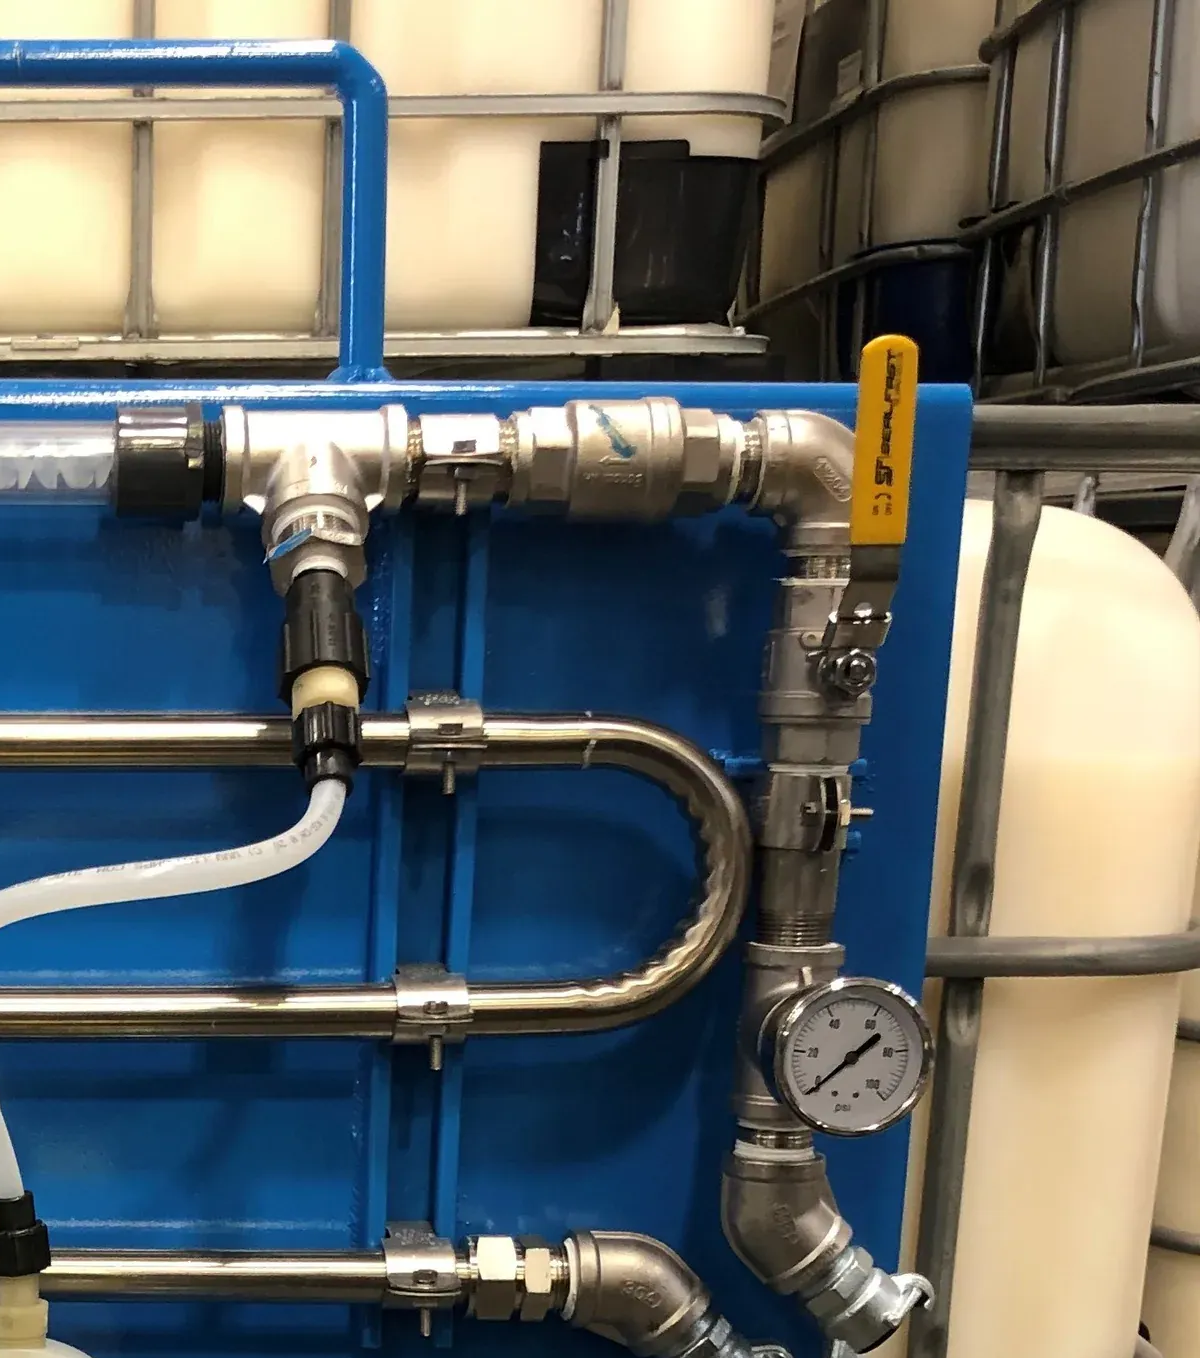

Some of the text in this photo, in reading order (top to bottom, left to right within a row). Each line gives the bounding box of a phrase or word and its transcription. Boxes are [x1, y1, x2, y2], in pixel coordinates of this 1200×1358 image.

[881, 348, 897, 456] SEALFAST
[828, 1019, 840, 1030] 40
[864, 1019, 876, 1030] 60
[807, 1047, 819, 1058] 20
[882, 1047, 893, 1058] 80
[865, 1079, 880, 1090] 100
[833, 1104, 851, 1113] psi
